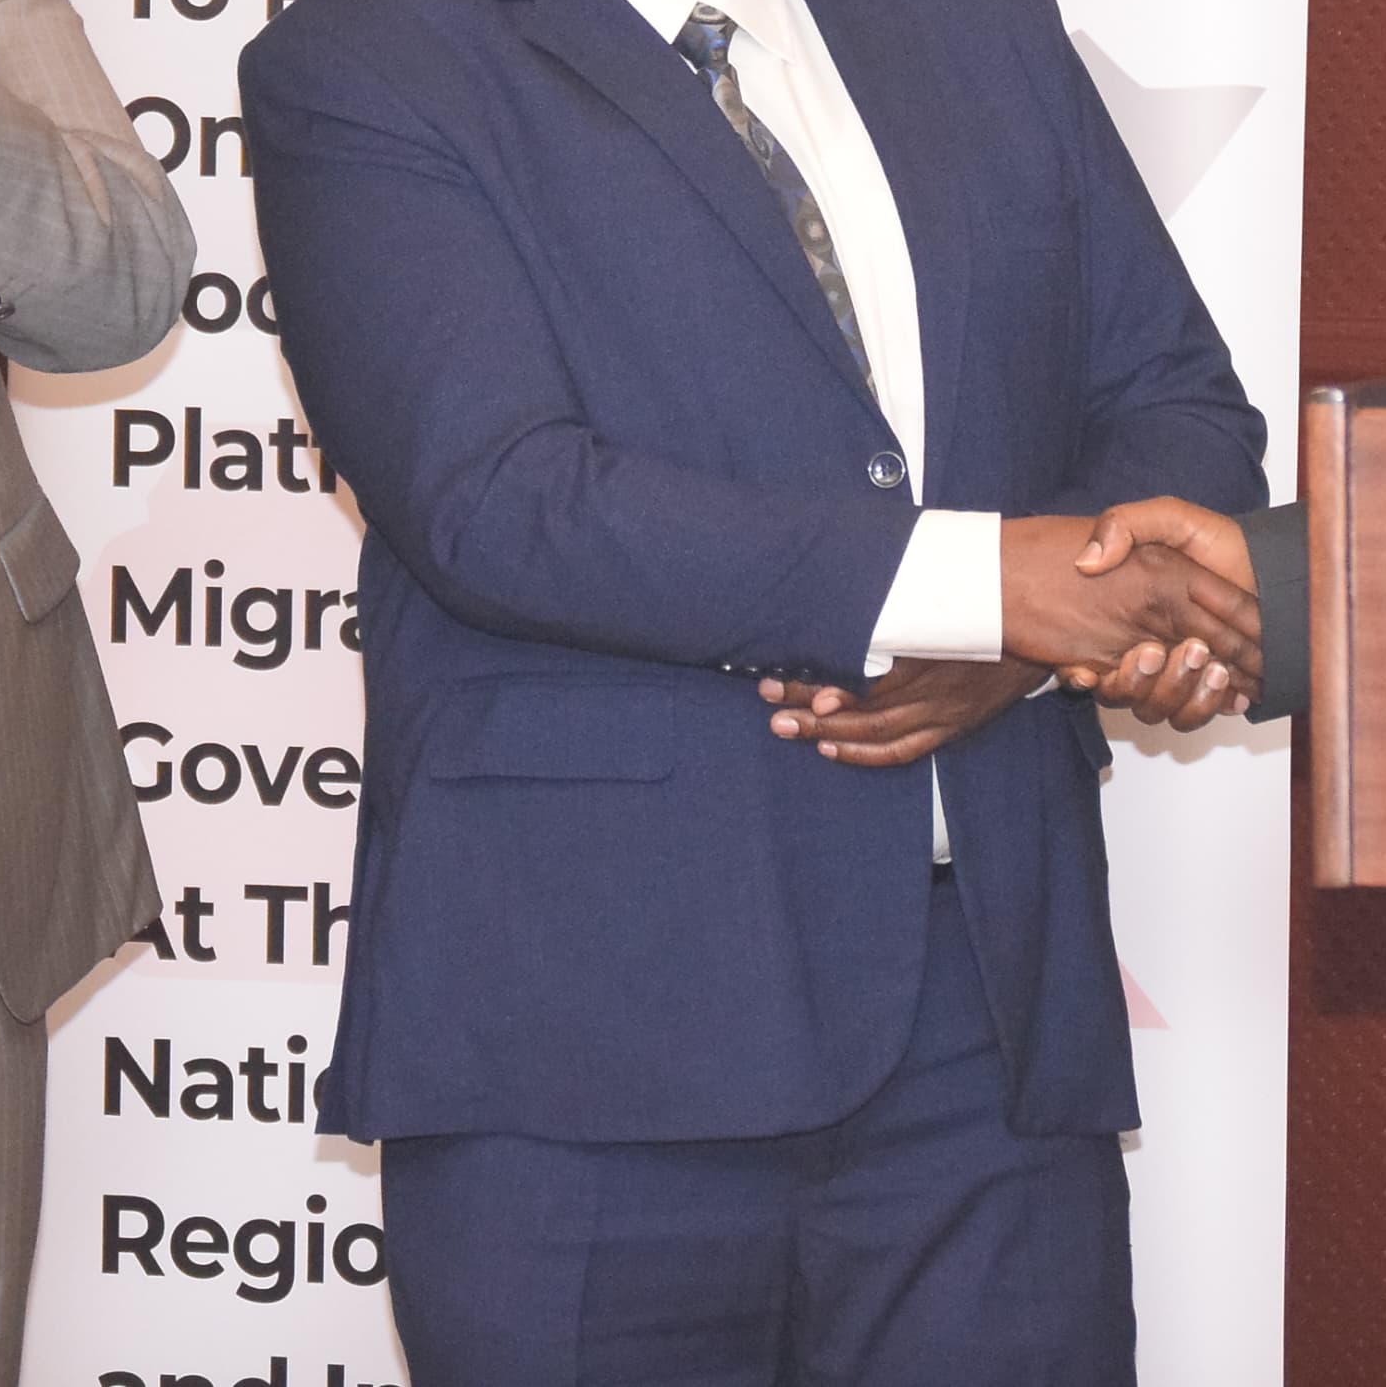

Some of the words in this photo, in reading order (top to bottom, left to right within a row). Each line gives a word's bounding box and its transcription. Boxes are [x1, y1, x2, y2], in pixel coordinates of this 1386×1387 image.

[123, 95, 255, 178] On
[110, 558, 364, 672] Migr
[117, 721, 362, 810] Gove
[244, 881, 351, 967] Th
[103, 1033, 327, 1125] Nati
[101, 1193, 386, 1304] Regio
